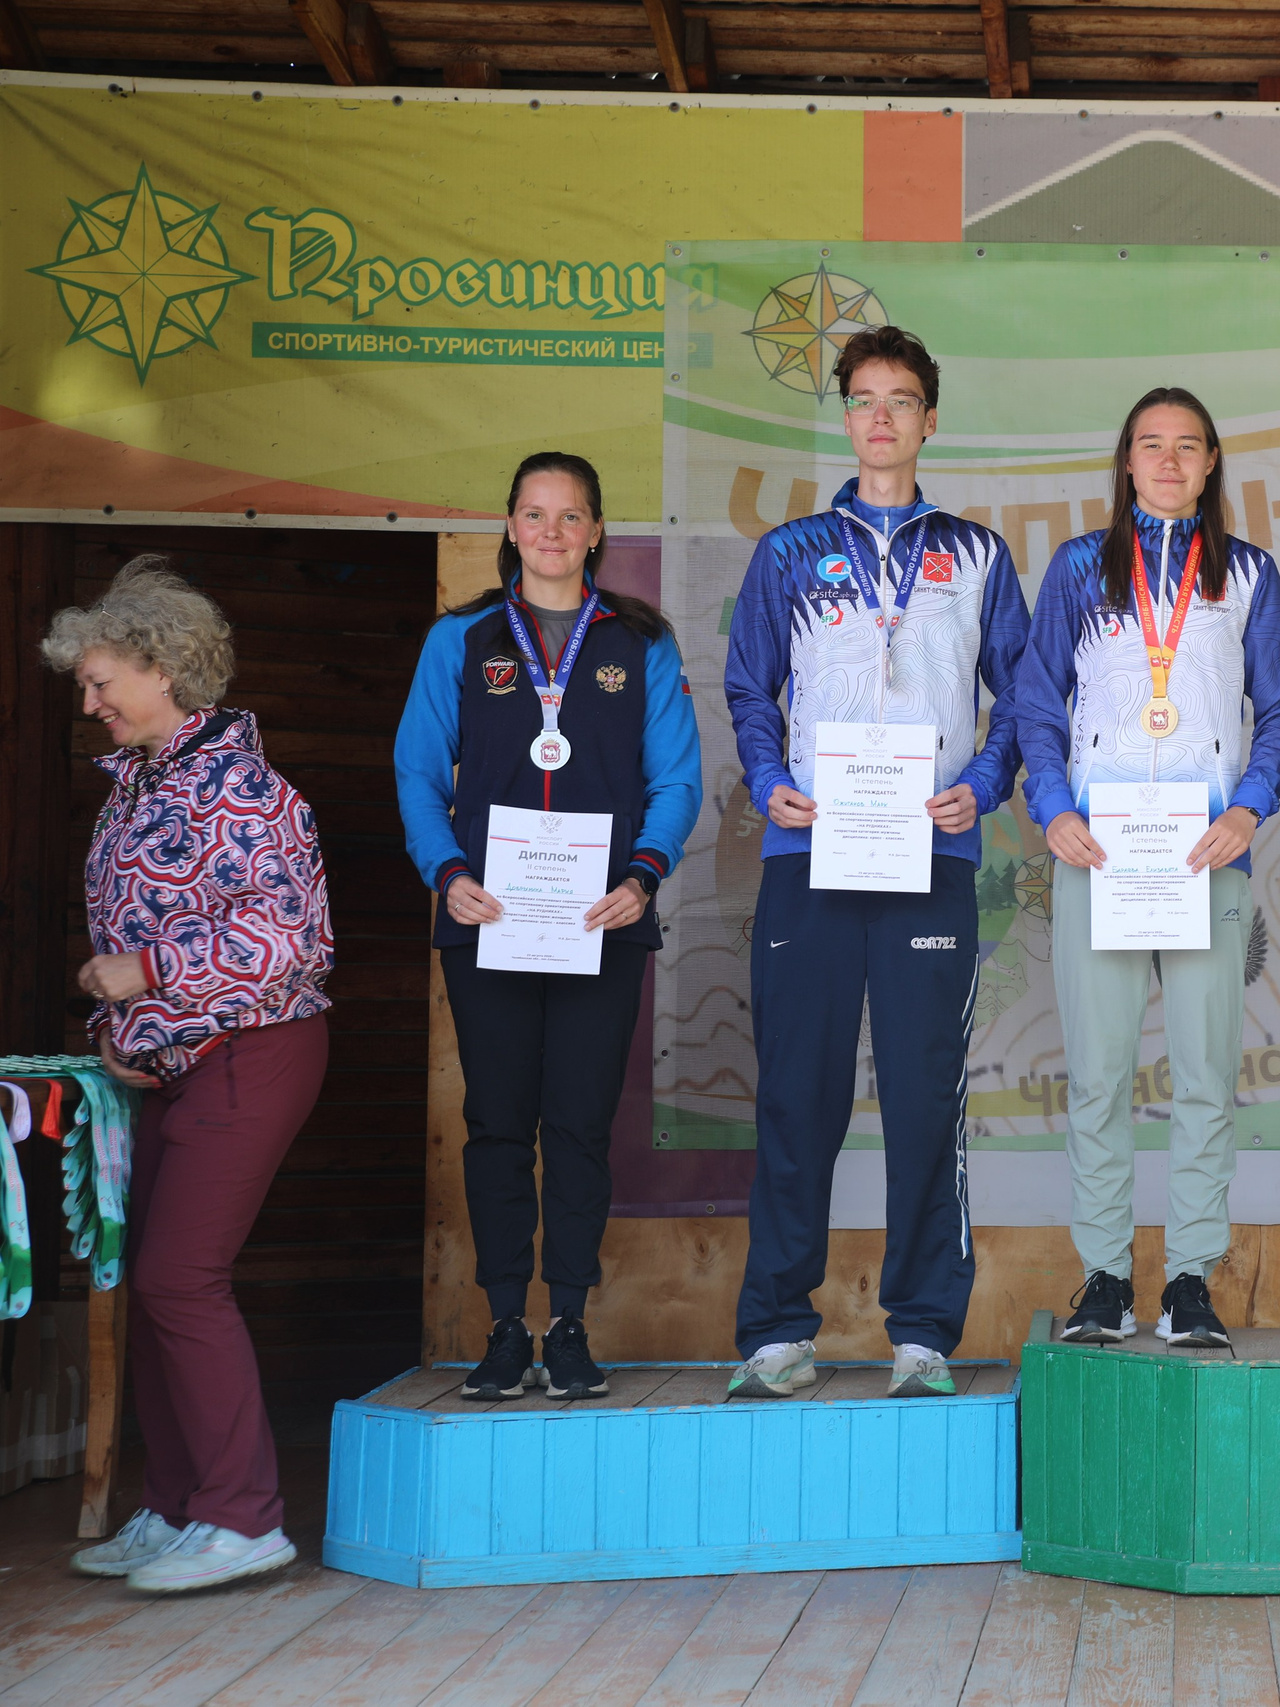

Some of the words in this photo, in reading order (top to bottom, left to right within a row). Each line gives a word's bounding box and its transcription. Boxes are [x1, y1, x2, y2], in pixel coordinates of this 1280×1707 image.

[268, 331, 616, 359] СПОРТИВНО-ТУРИСТИЧЕСКИЙ
[623, 341, 697, 361] ЦЕНР
[850, 547, 872, 596] ЧЕЛЯБИНСКАЯ
[900, 562, 915, 595] ОБЛАСТЬ
[1182, 545, 1200, 598] ЧЕЛЯБИНСКАЯ
[821, 615, 834, 624] SFR
[1135, 577, 1152, 633] ЧЕЛЯБИНСКАЯ
[1171, 598, 1187, 634] ОБЛАСТЬ
[485, 660, 515, 668] FORWARD
[561, 639, 579, 673] ОБЛАСТЬ
[846, 765, 903, 775] ДИПЛОМ
[1122, 824, 1178, 834] ДИПЛОМ
[518, 850, 577, 862] ДИПЛОМ
